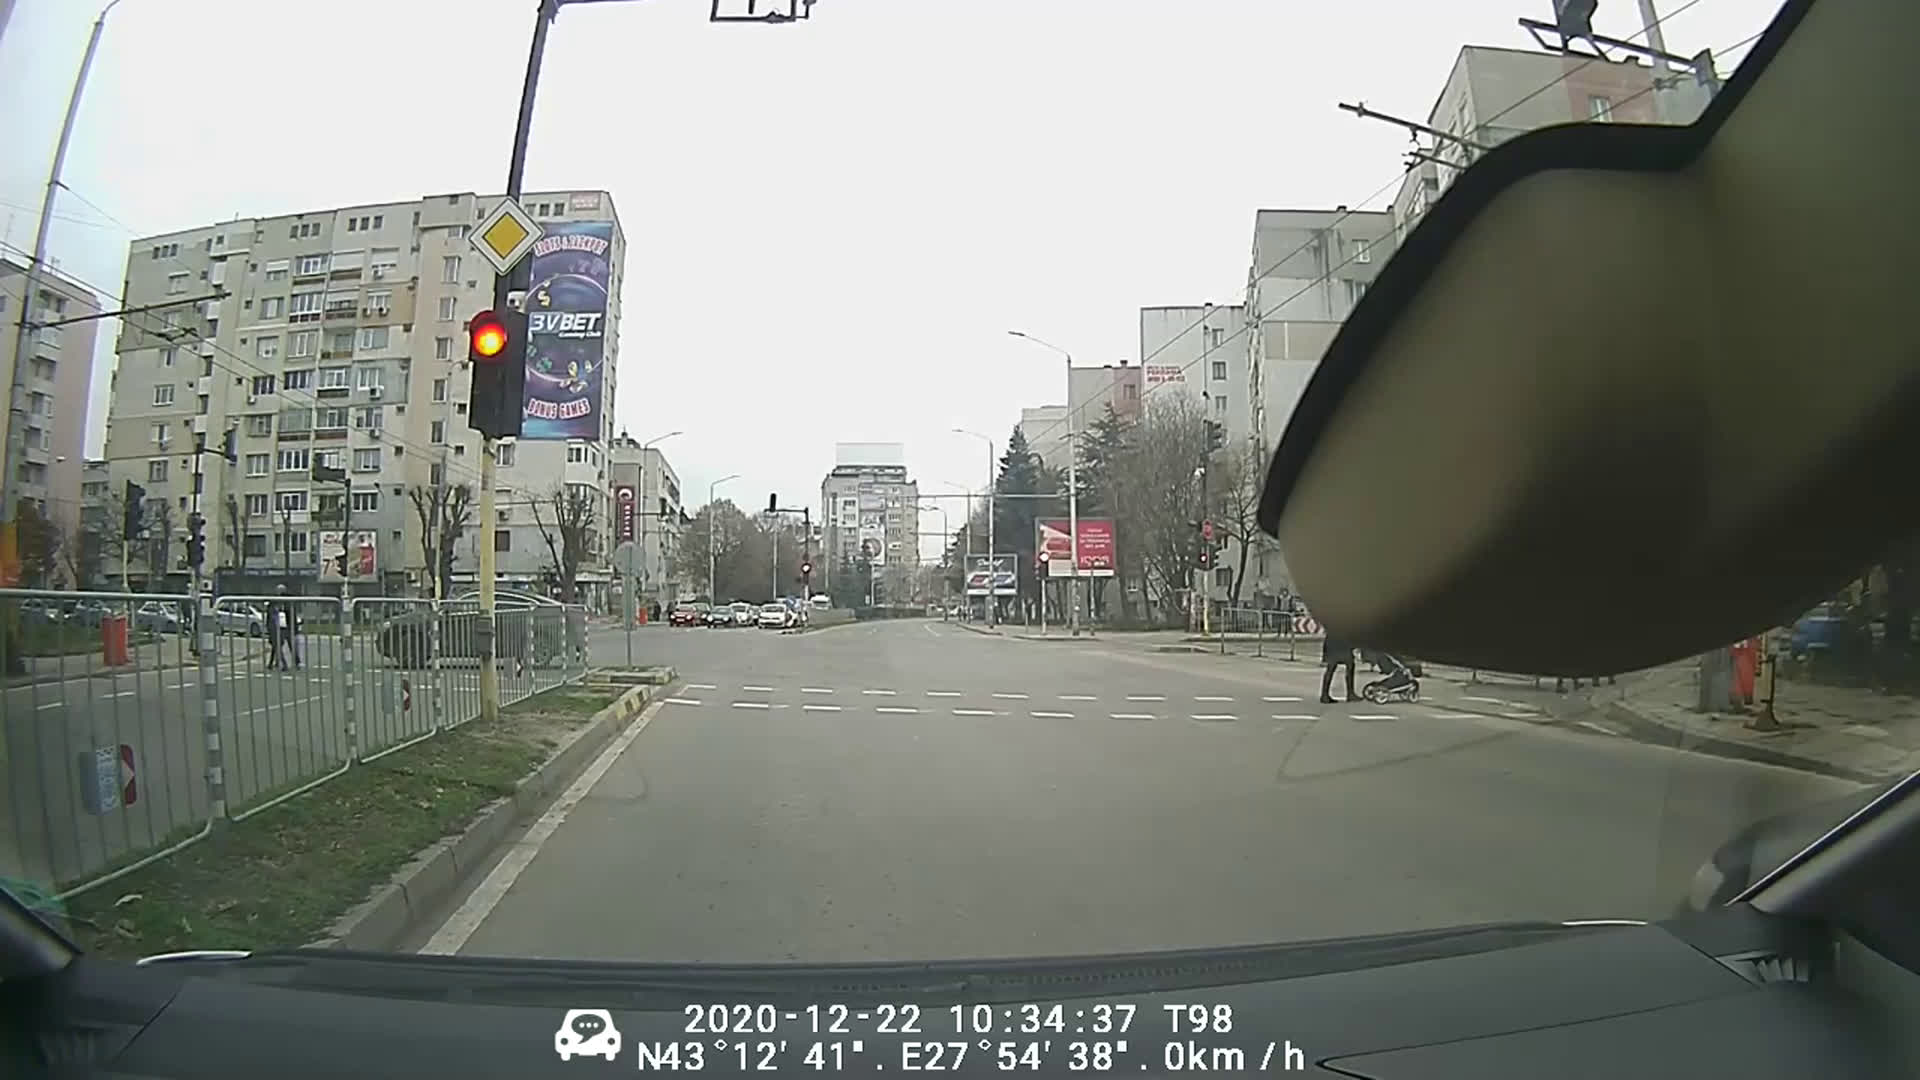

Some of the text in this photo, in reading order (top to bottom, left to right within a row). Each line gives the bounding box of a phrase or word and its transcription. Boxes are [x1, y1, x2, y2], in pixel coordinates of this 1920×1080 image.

[530, 313, 602, 331] 3VBET
[528, 398, 591, 419] BONUS GAMES
